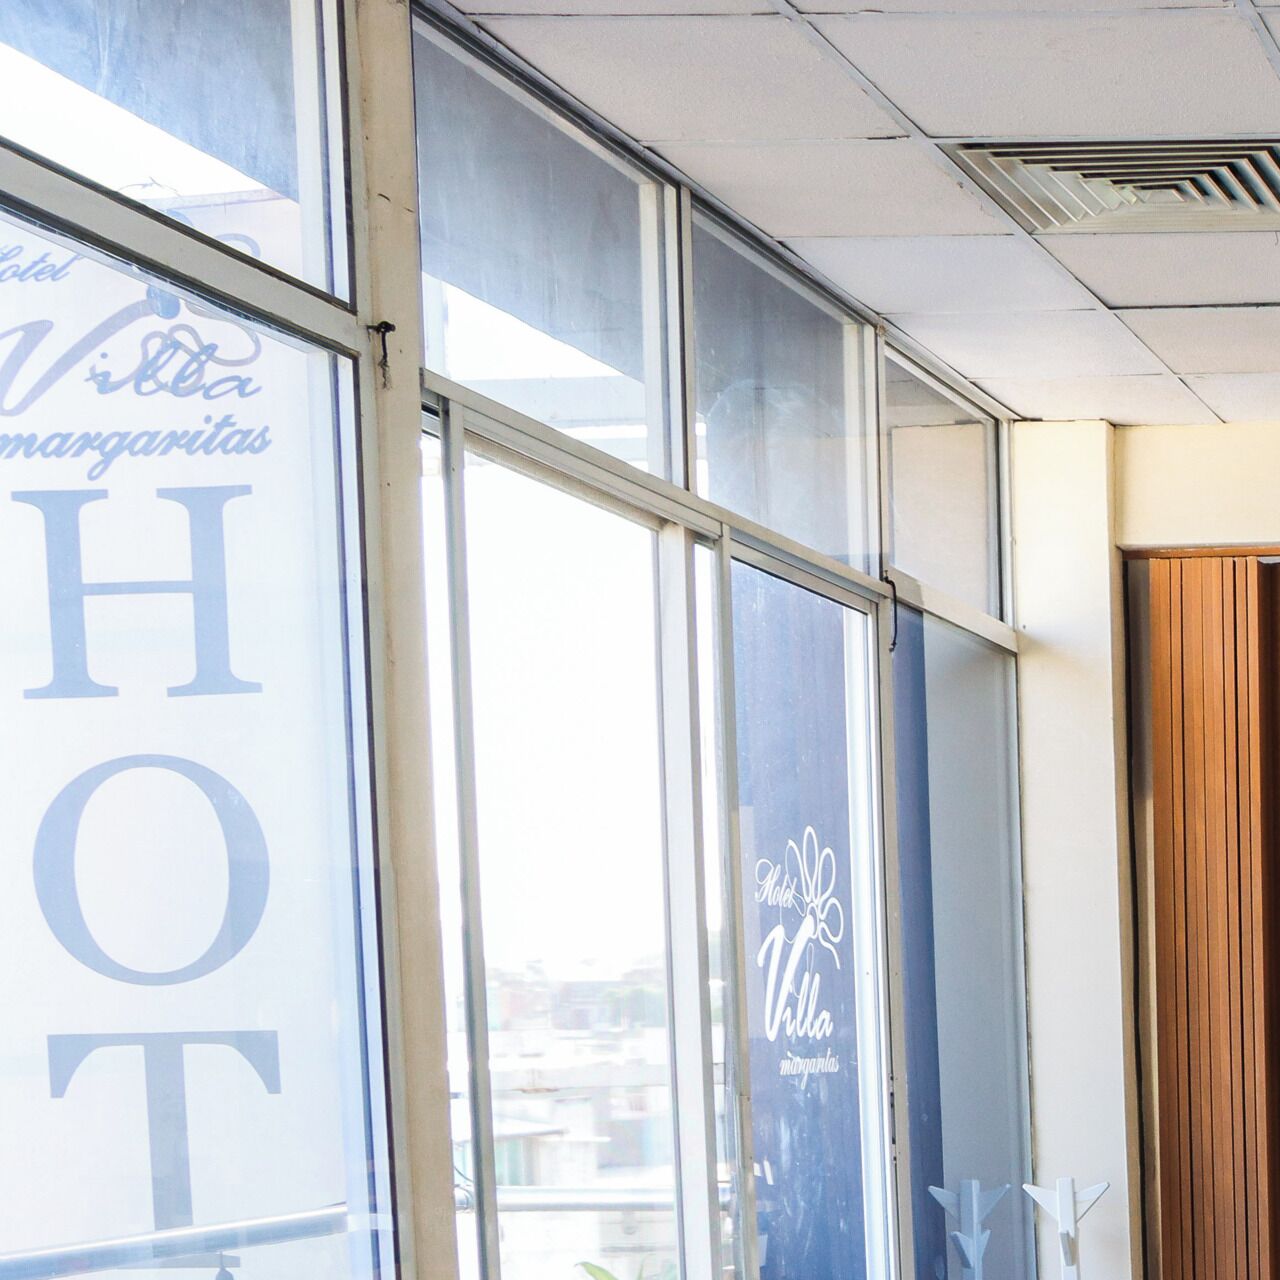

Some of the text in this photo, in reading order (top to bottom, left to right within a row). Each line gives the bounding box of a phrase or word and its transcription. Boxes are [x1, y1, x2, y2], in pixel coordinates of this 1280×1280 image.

[0, 414, 272, 481] margaritas
[755, 858, 797, 909] Hotel
[757, 915, 833, 1042] Villa
[780, 1048, 839, 1089] margaritas
